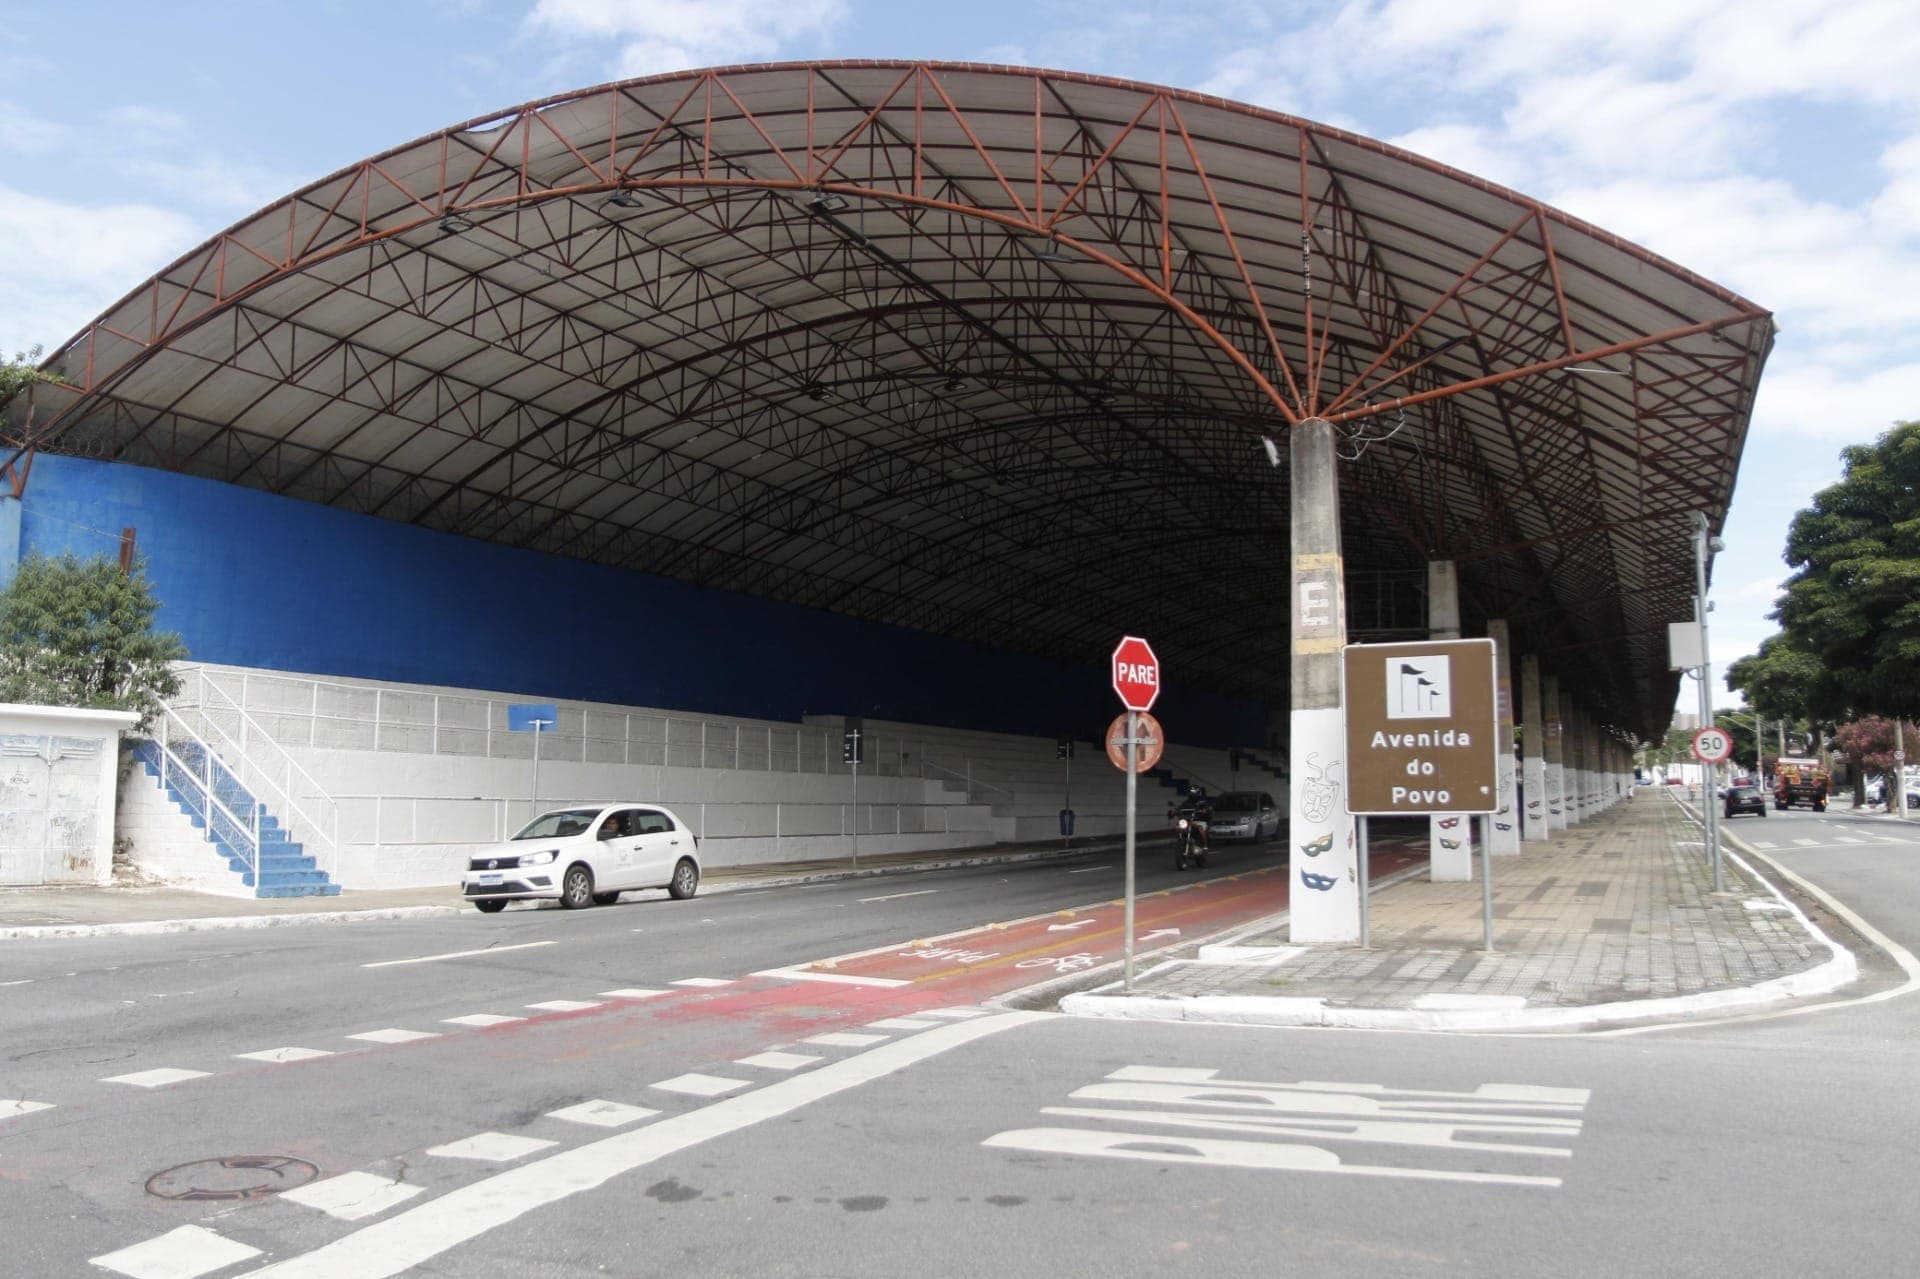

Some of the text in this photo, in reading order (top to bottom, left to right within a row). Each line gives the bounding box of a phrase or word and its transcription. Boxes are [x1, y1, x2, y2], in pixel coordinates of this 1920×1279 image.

[1301, 581, 1328, 626] E
[1118, 662, 1156, 685] PARE
[1371, 730, 1471, 748] Avenida
[1701, 736, 1722, 751] 50
[1406, 758, 1435, 775] do
[1392, 786, 1450, 804] Povo
[981, 1065, 1592, 1187] PARE
